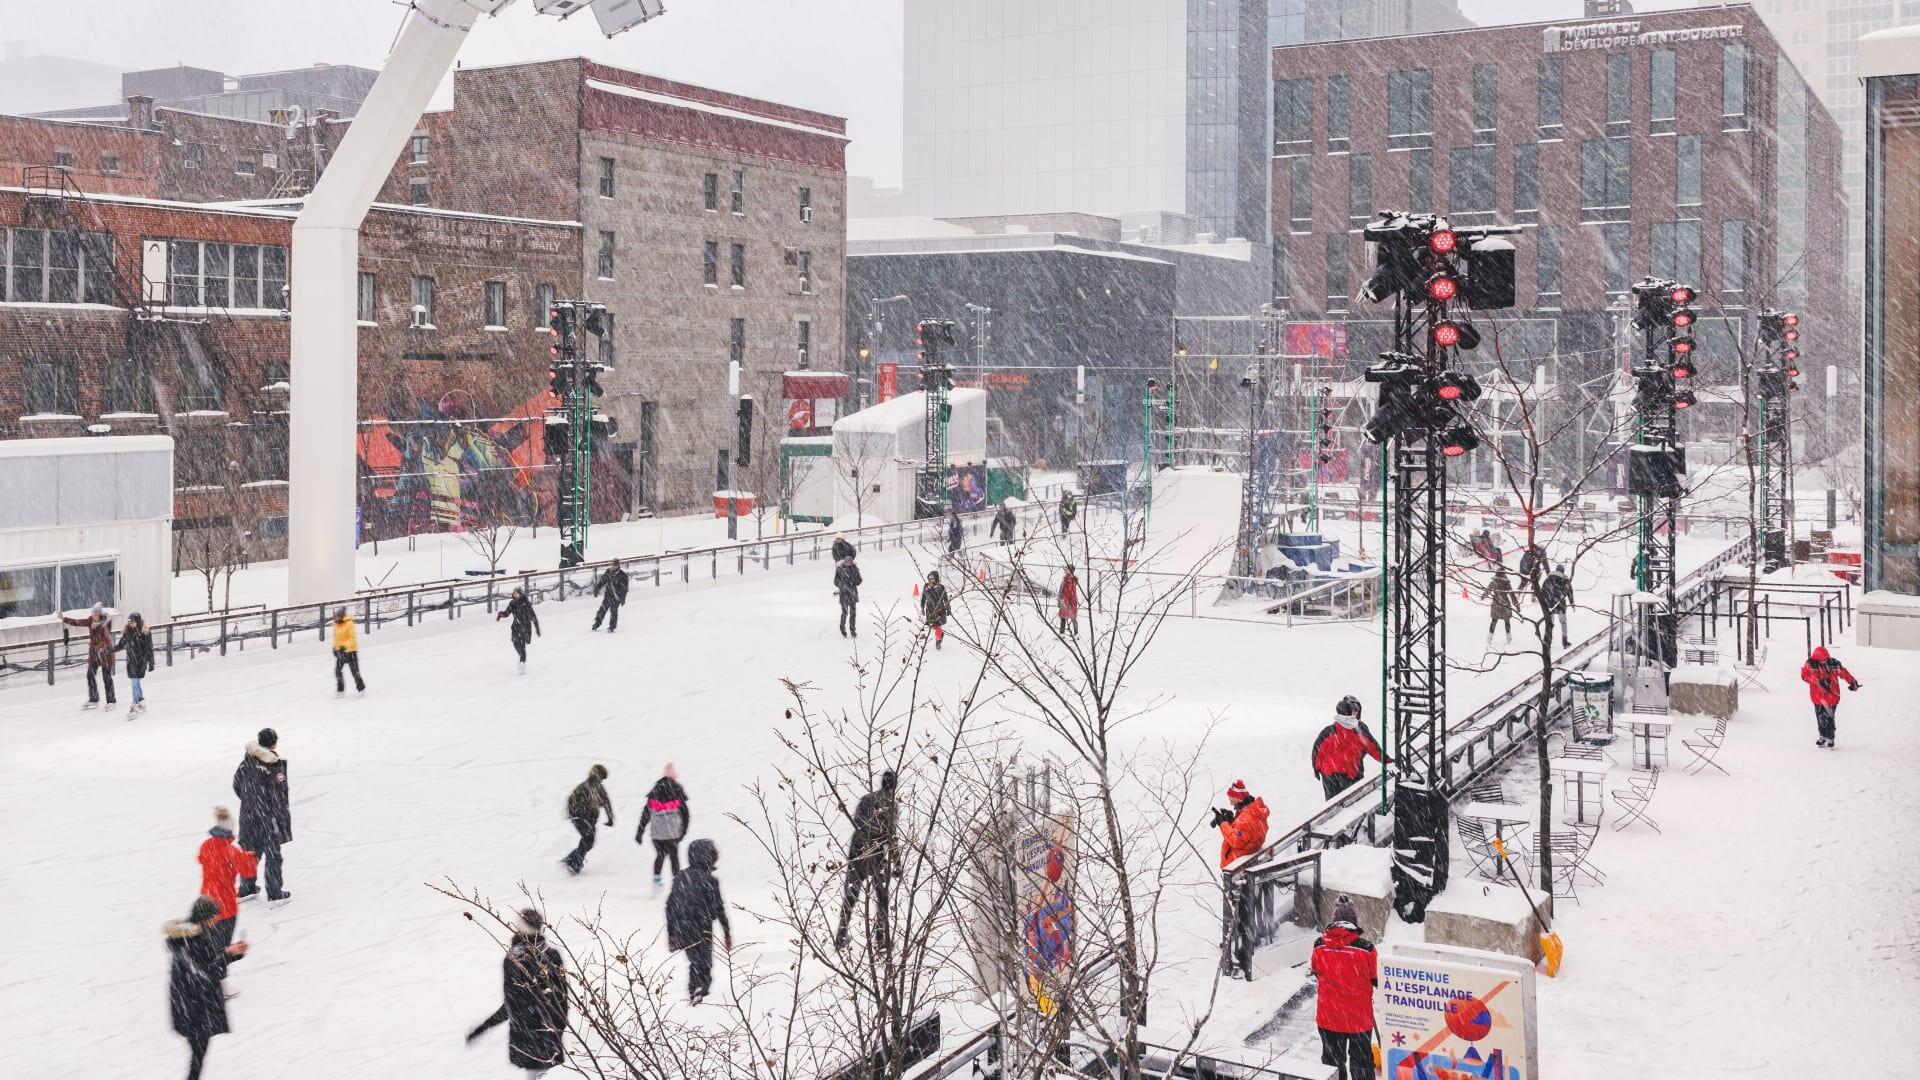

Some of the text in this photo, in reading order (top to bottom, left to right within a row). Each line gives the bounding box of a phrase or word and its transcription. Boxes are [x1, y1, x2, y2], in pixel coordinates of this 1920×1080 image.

[1565, 21, 1641, 39] MAISON DU
[1680, 25, 1745, 42] DURABLE
[1383, 966, 1450, 984] BIENVENUE
[1383, 977, 1473, 1002] À L'ESPLANADE
[1384, 994, 1458, 1014] TRANQUILLE
